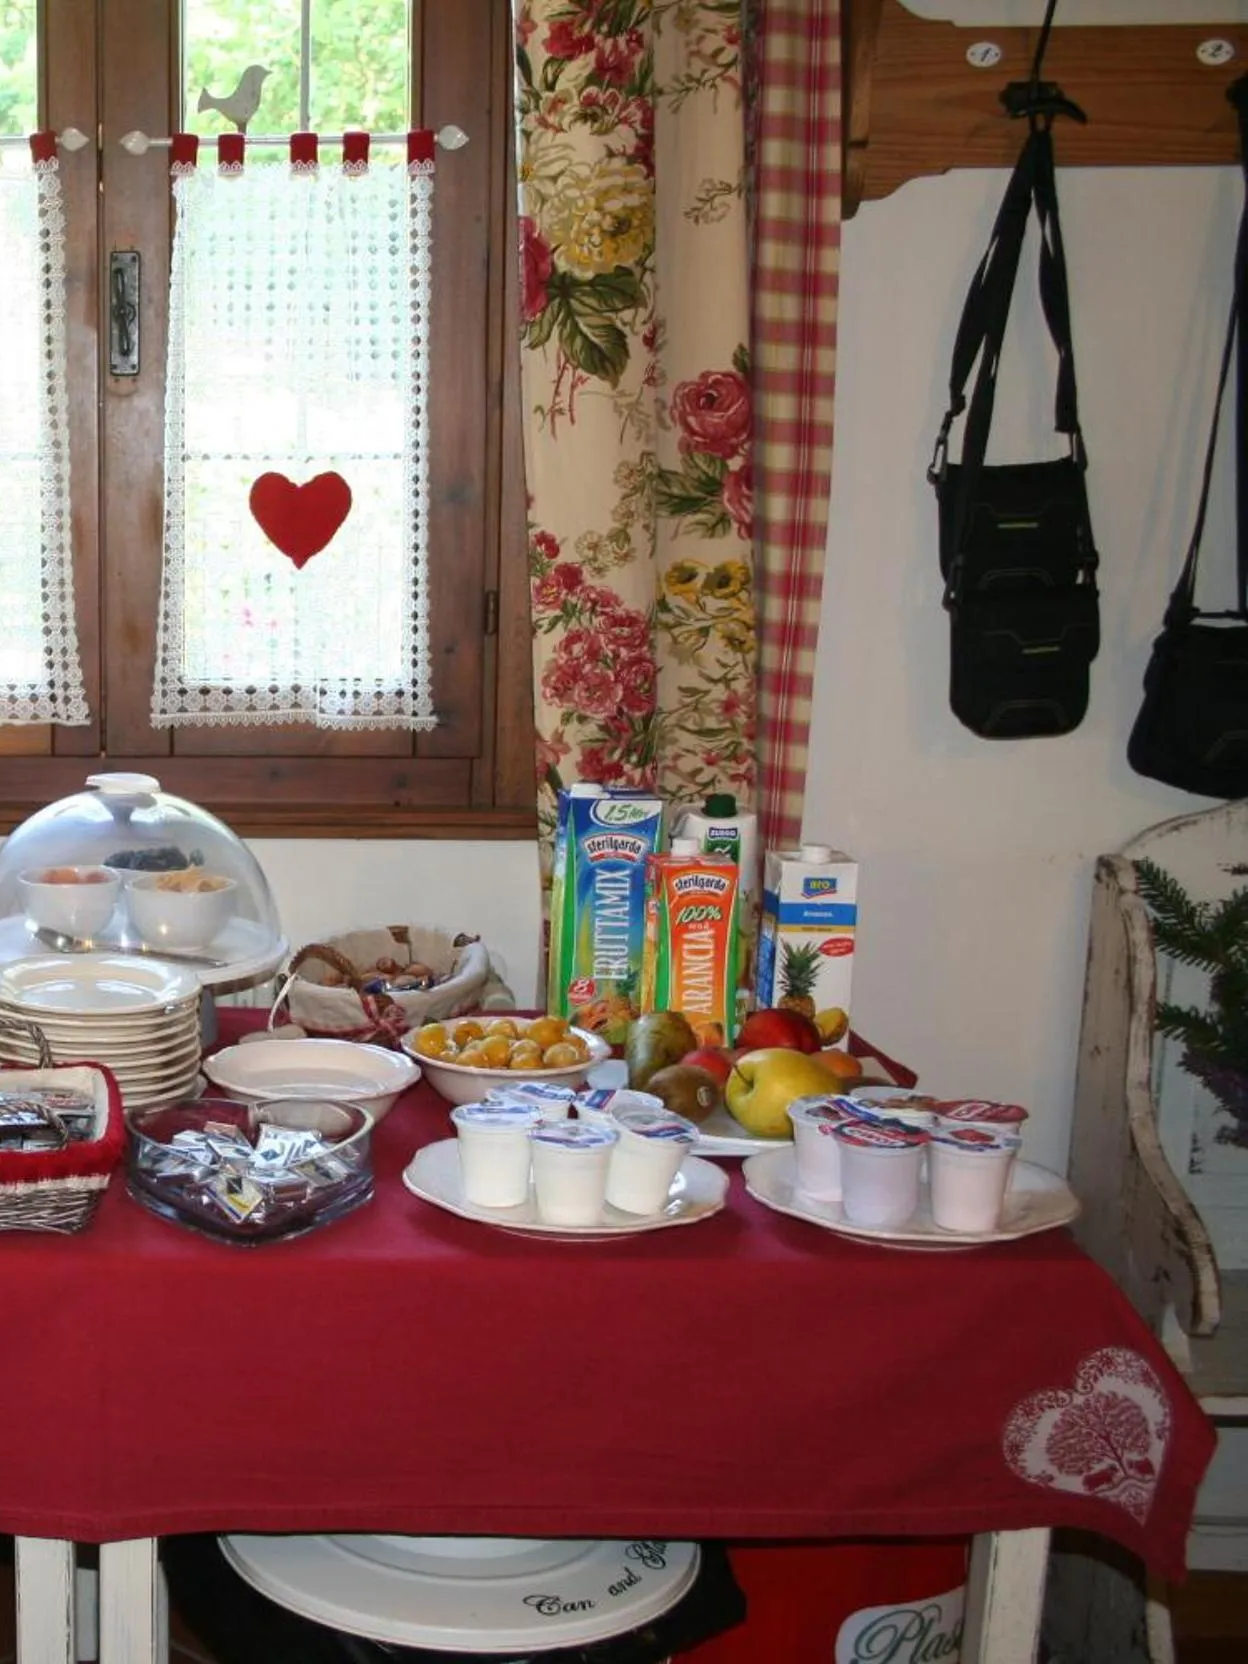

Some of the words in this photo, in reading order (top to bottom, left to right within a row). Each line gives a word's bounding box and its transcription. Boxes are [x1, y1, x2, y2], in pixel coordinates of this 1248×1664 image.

[593, 868, 631, 980] FRUTTAMIX
[681, 927, 716, 1014] ARANCIA
[522, 1594, 596, 1617] Can
[606, 1566, 642, 1597] and
